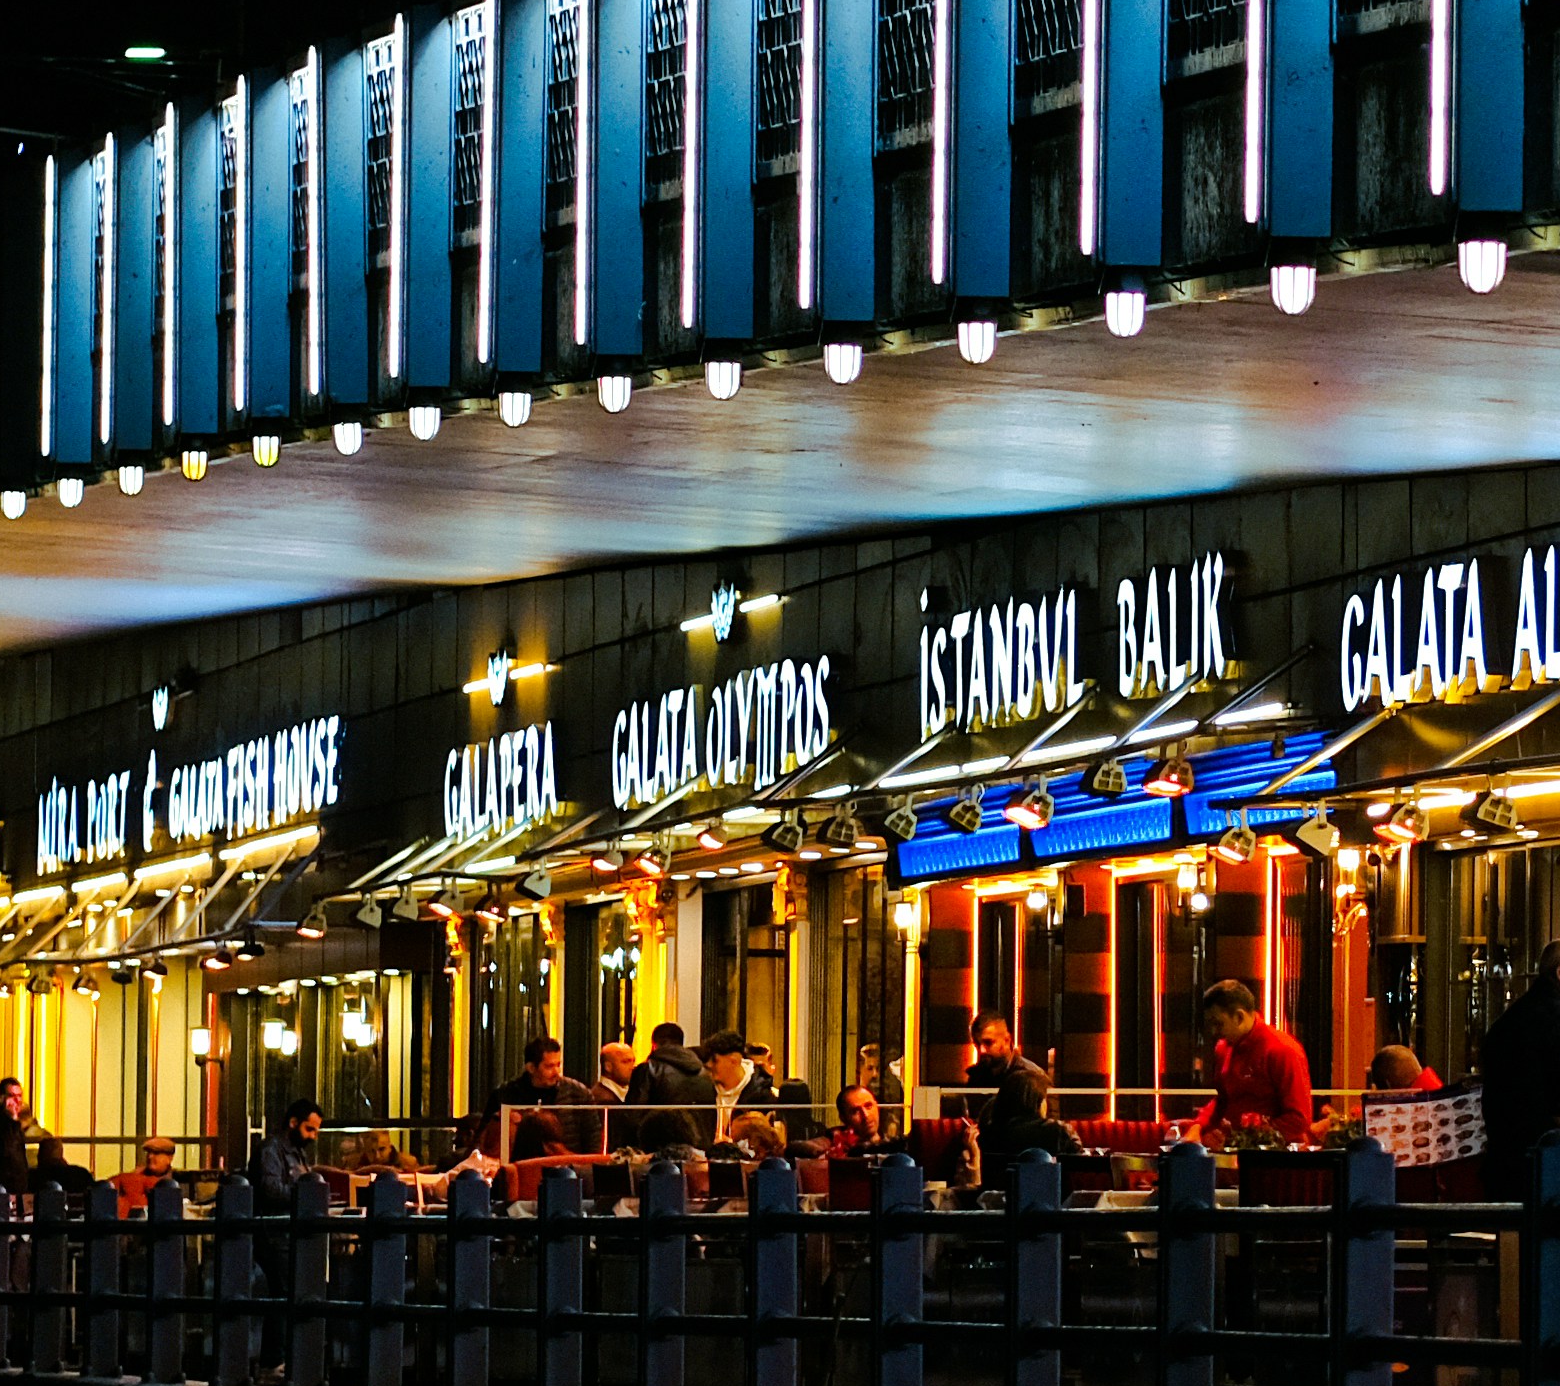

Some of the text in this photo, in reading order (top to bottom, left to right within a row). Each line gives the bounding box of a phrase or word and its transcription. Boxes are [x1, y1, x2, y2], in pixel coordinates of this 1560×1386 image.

[920, 550, 1228, 745] İSTANBUL BALIK
[1342, 557, 1486, 713] GALATA
[86, 769, 131, 865] PORT
[168, 755, 224, 845] GALATA
[226, 733, 270, 841] FISH
[273, 714, 340, 818] HOUSE
[443, 720, 558, 844] GALAPERA
[612, 653, 832, 813] GALATA OLYMPOS
